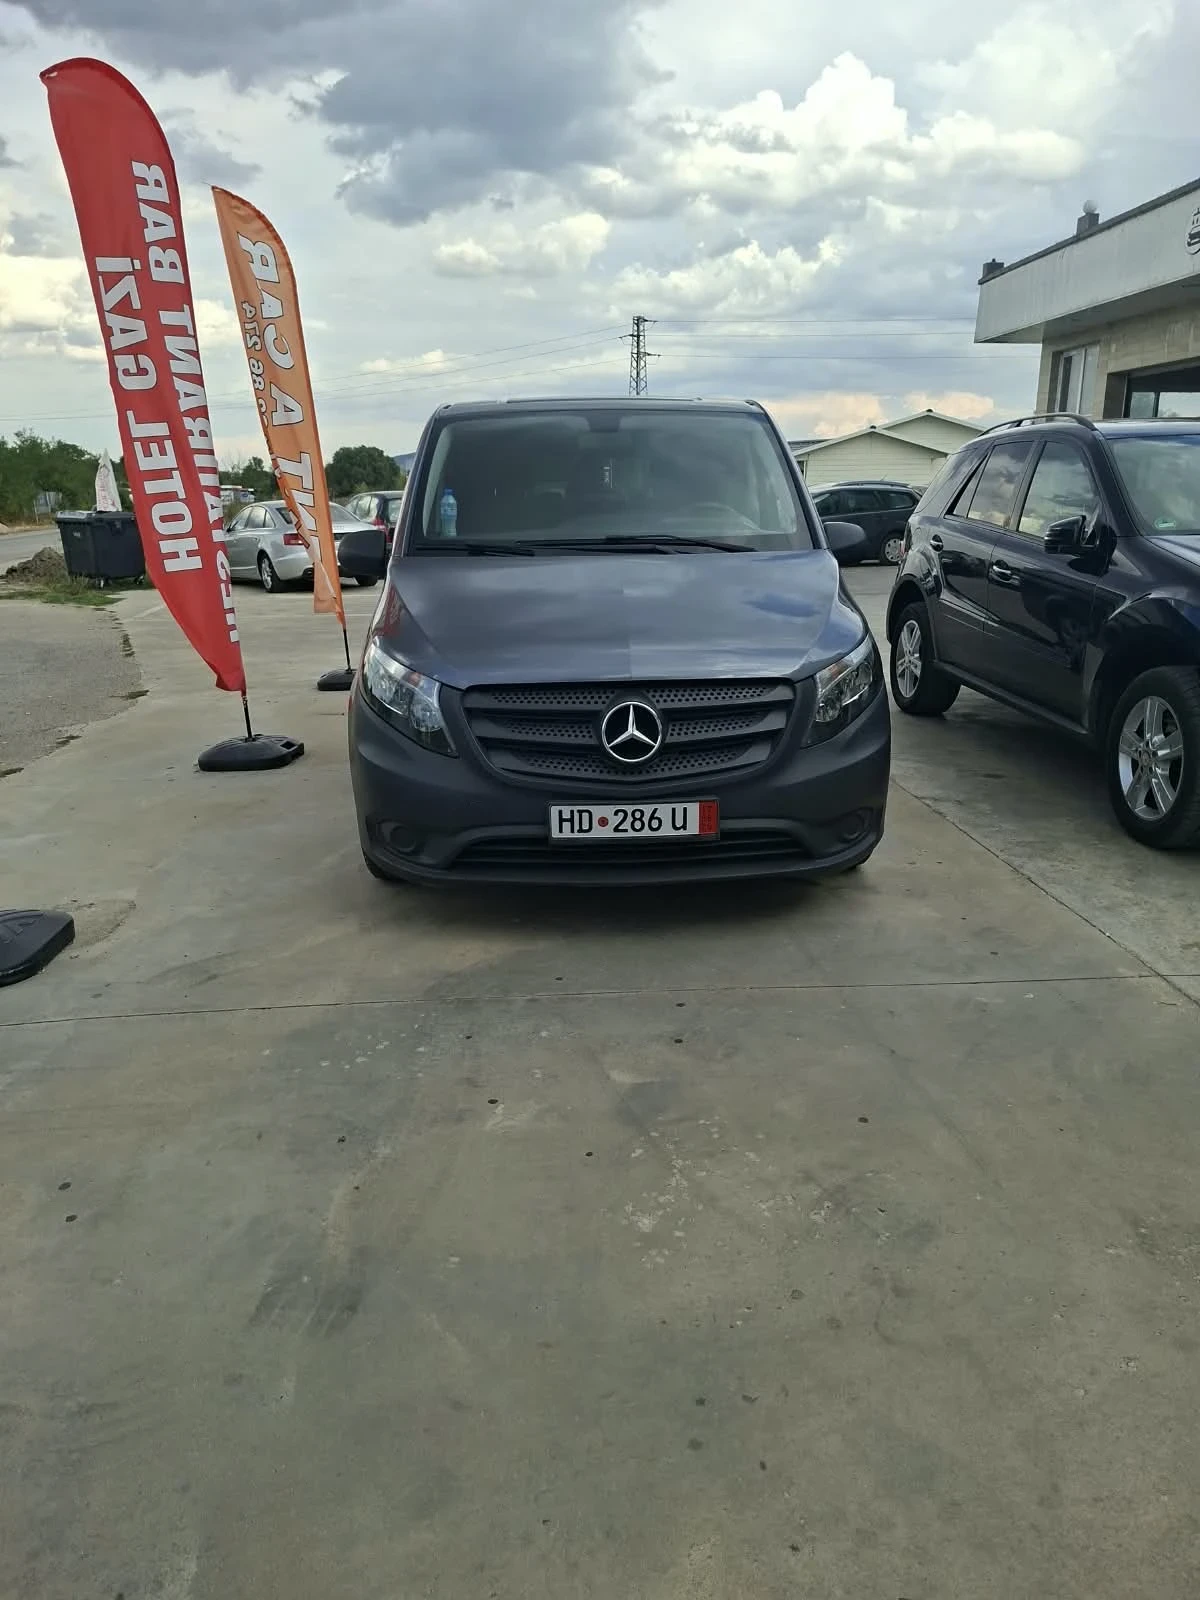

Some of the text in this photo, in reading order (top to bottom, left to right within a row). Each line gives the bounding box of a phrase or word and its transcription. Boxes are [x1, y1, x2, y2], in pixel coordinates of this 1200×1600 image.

[558, 809, 593, 834] HD
[613, 807, 663, 833] 286
[671, 806, 688, 831] U
